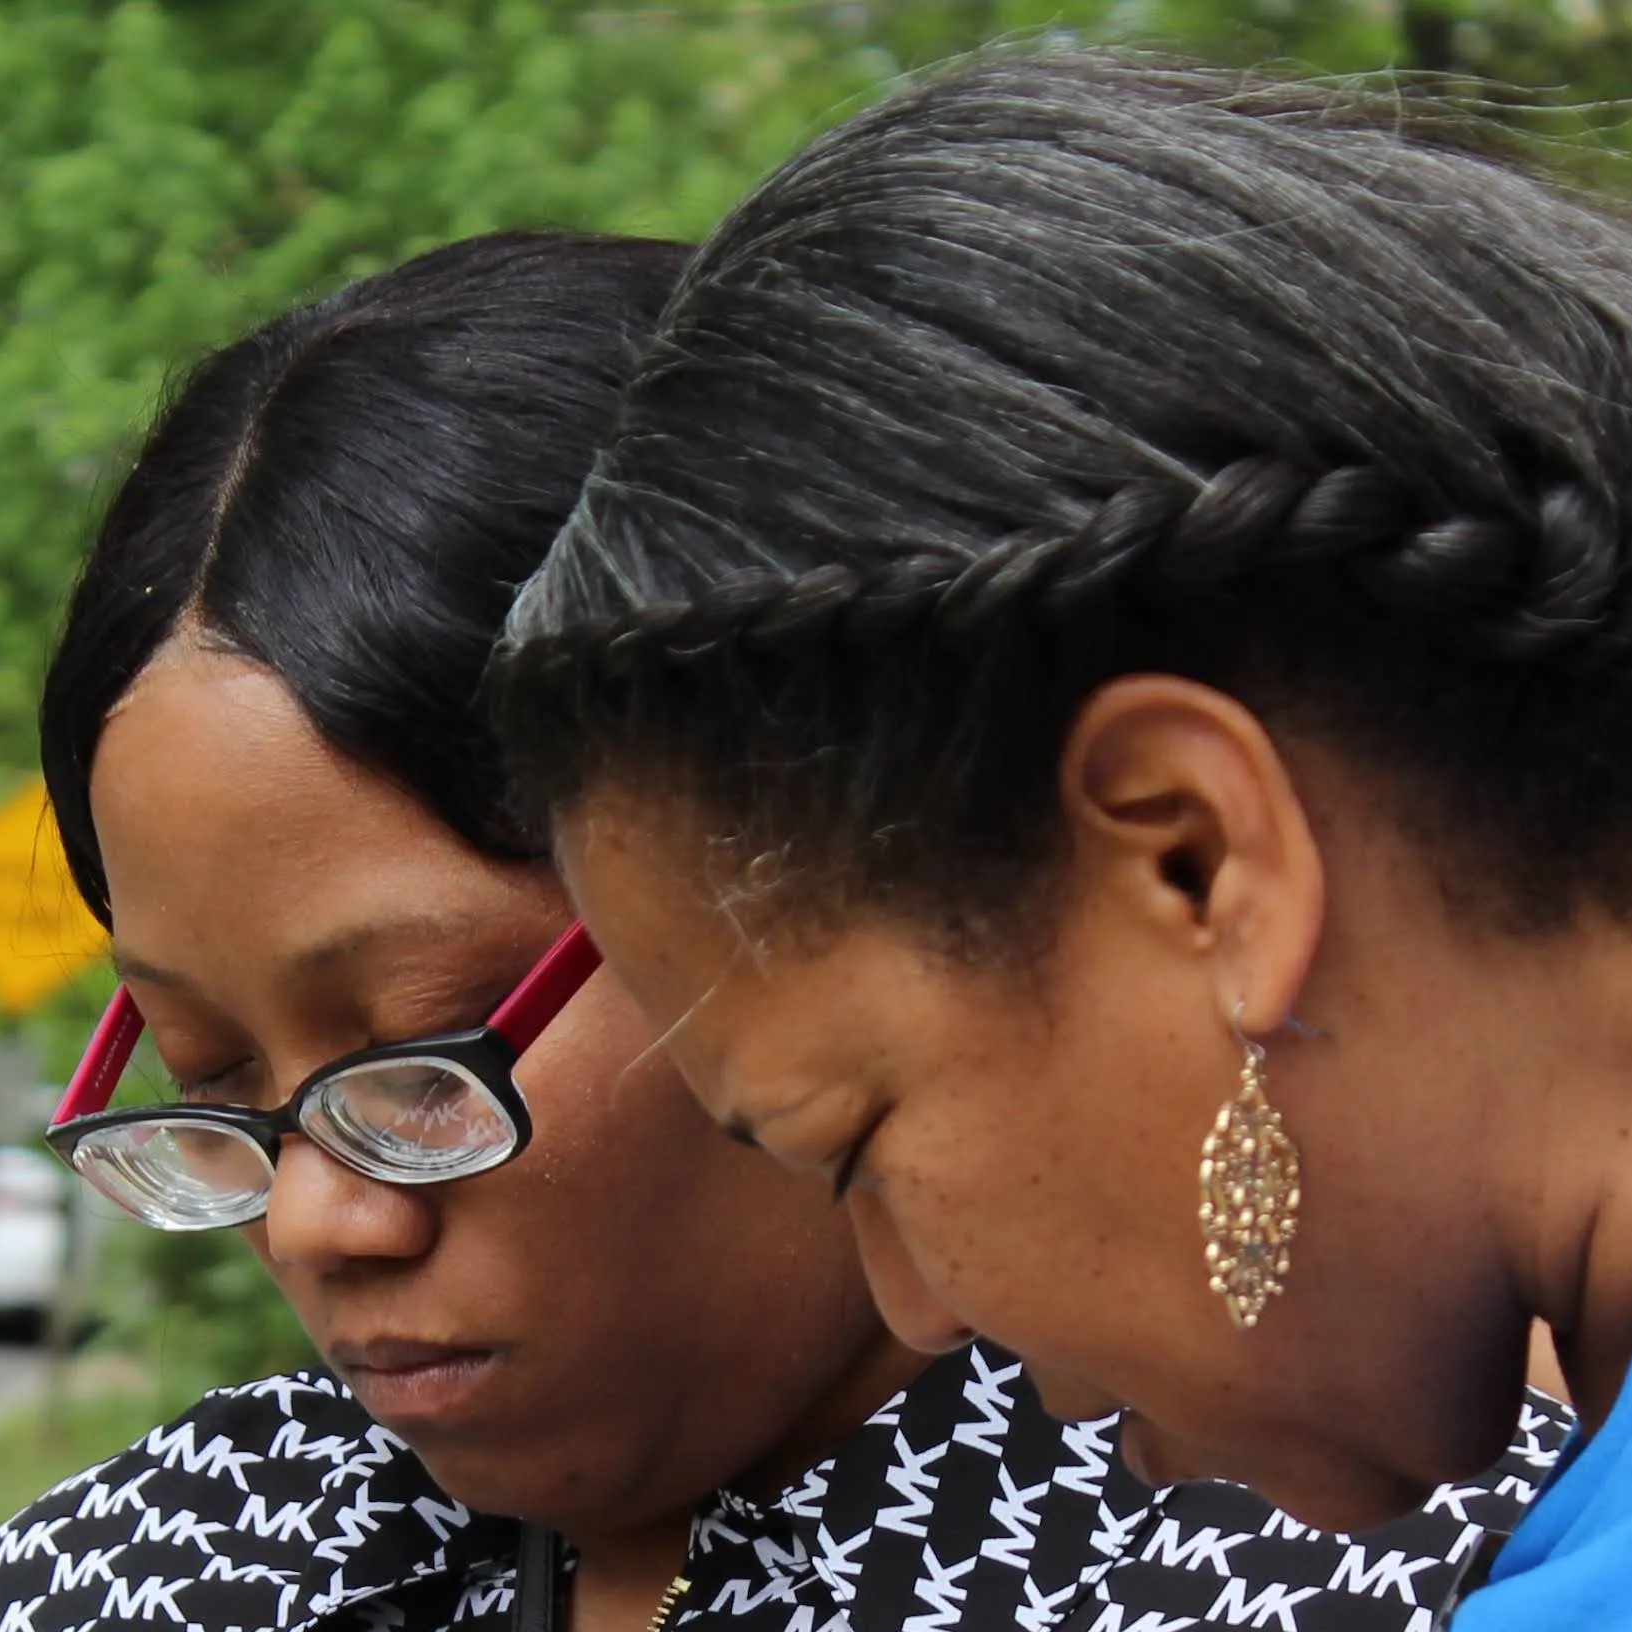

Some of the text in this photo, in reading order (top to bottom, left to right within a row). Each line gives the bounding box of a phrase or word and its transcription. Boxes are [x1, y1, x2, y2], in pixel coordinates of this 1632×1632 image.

[951, 1344, 1023, 1458] MK
[875, 1428, 949, 1538] MK
[1052, 1411, 1120, 1498] MK
[131, 1506, 230, 1554] MK
[235, 1494, 325, 1542] MK
[979, 1462, 1050, 1570] MK
[48, 1543, 129, 1596] MK
[1140, 1518, 1255, 1577] MK
[1327, 1544, 1441, 1606] MK
[99, 1575, 195, 1624] MK
